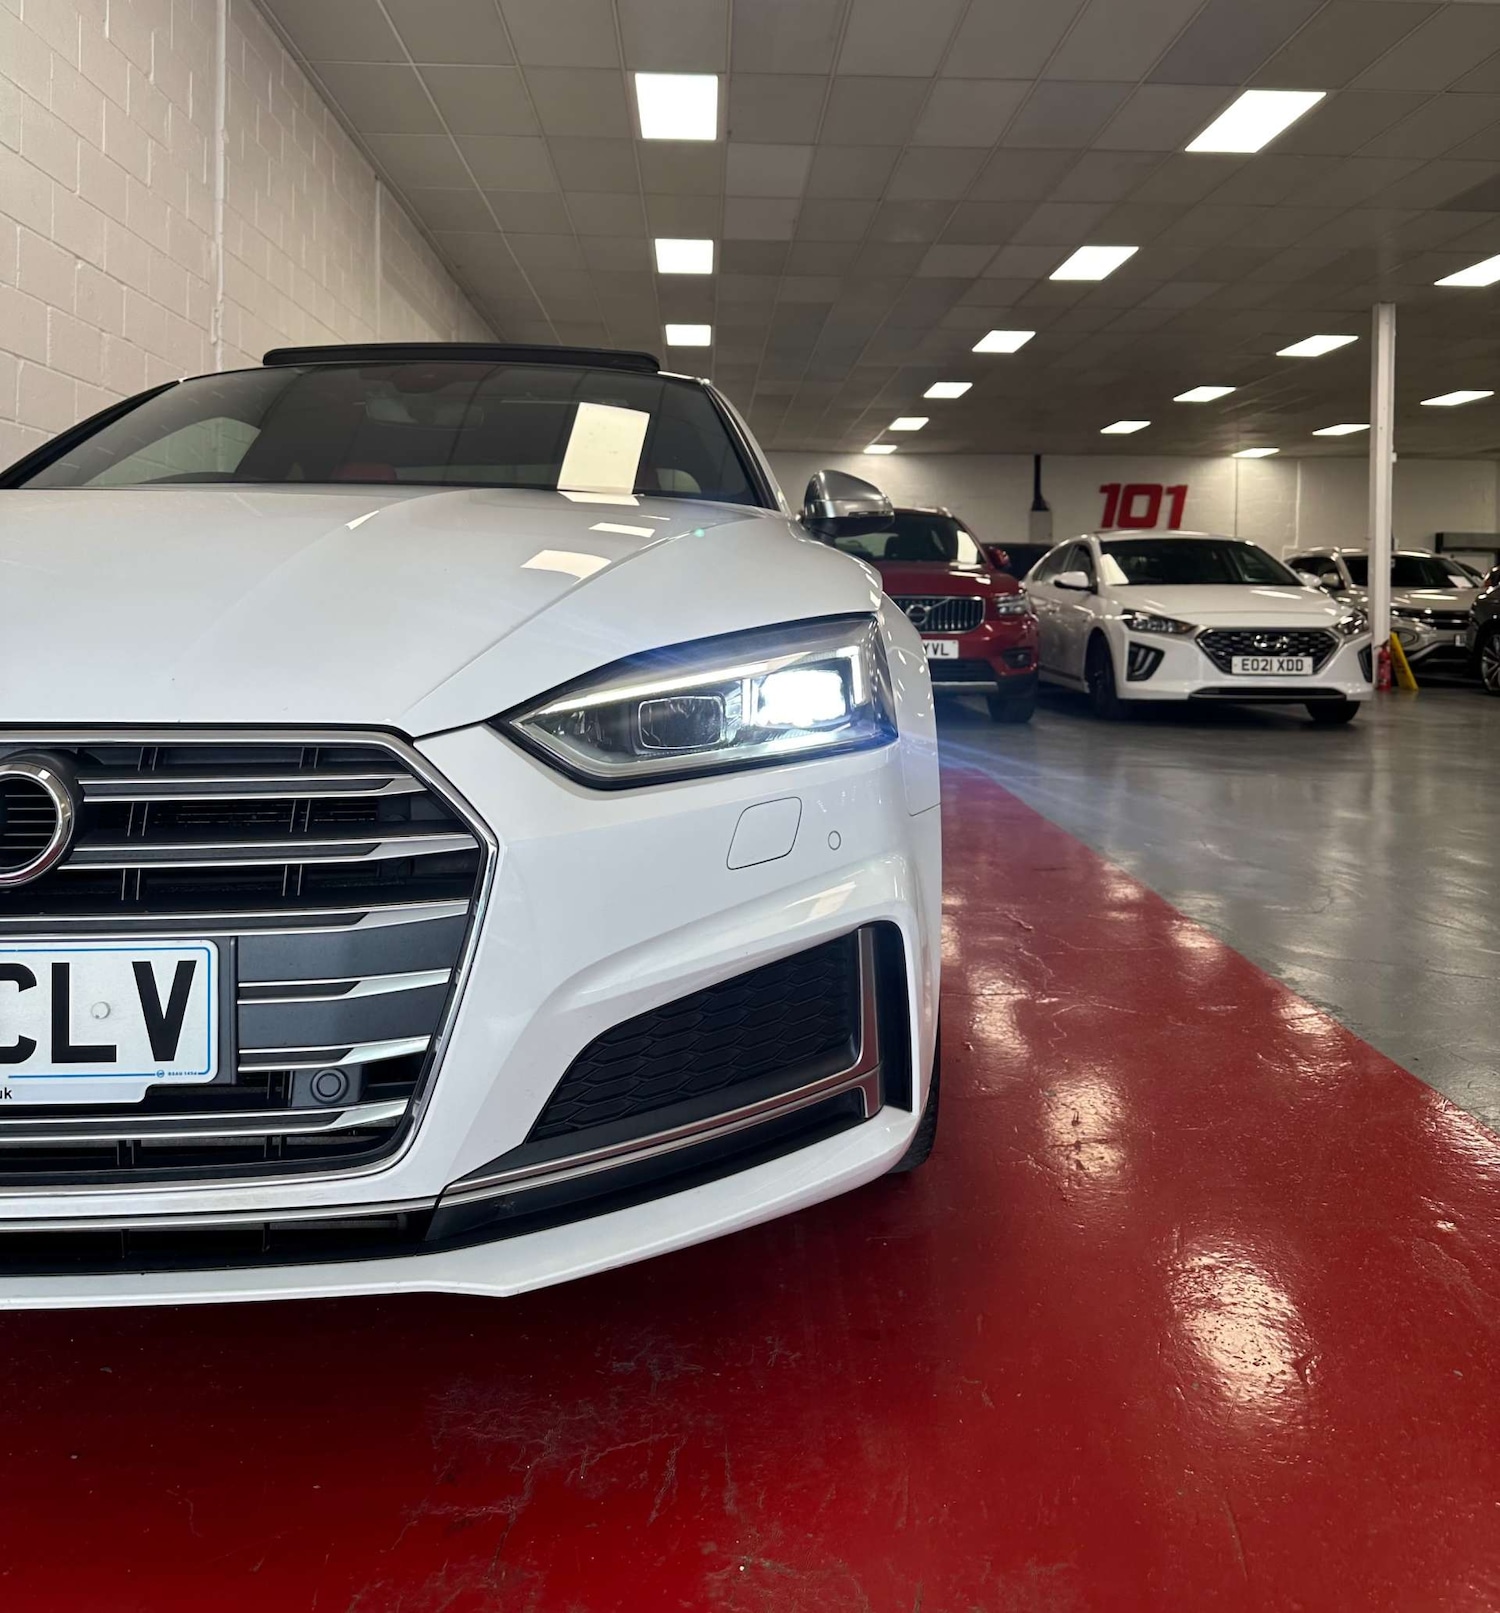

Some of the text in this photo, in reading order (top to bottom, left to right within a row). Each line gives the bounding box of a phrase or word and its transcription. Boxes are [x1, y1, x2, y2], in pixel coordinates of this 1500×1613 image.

[1099, 483, 1188, 530] 101
[923, 643, 950, 656] YVL
[1276, 658, 1304, 672] XDD
[0, 960, 197, 1063] CLV
